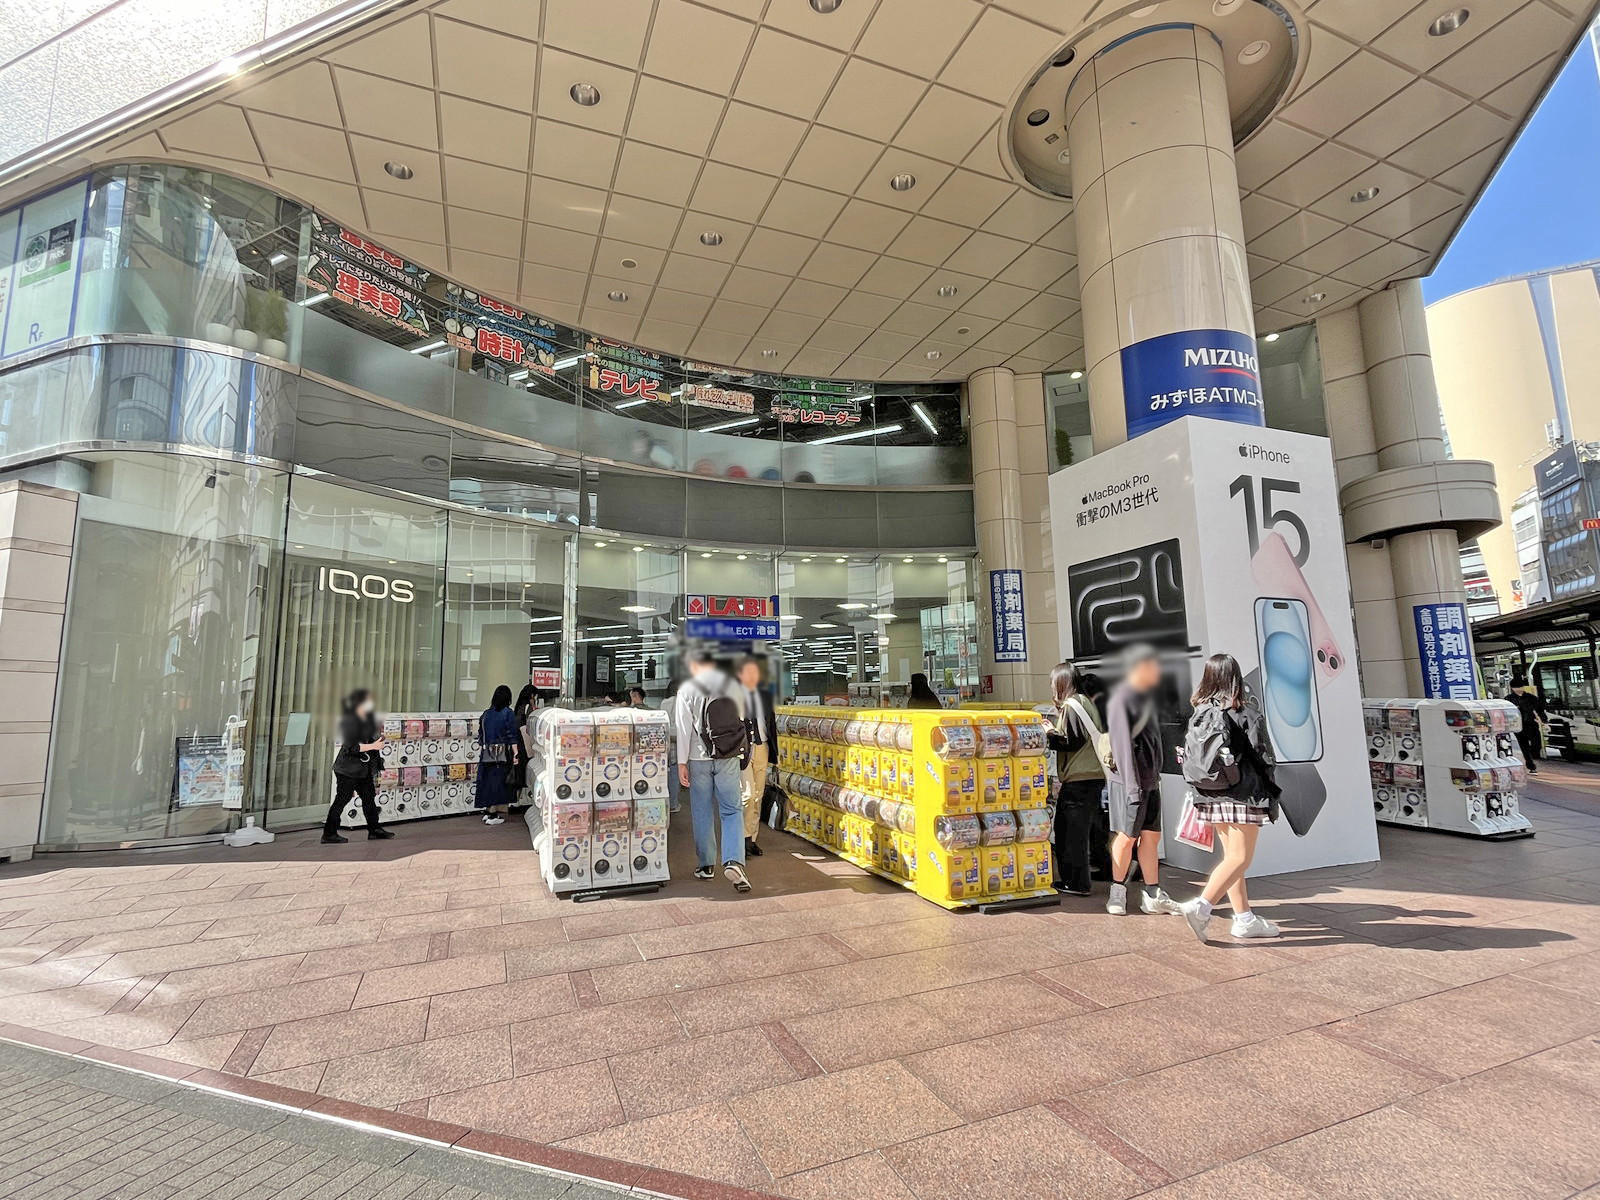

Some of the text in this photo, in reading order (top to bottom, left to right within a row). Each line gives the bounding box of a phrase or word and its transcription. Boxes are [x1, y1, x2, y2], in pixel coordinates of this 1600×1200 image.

[336, 268, 402, 317] 理美容
[478, 328, 525, 363] 時計
[1184, 347, 1258, 373] MIZUHO
[600, 368, 659, 401] テレビ
[800, 408, 860, 425] レコーダー
[1248, 445, 1291, 464] iPhone
[1088, 473, 1150, 503] MacBook Pro
[1075, 486, 1160, 528] 衝撃のM3世代
[1229, 474, 1311, 569] 15
[318, 566, 415, 603] IQOS
[1003, 573, 1024, 651] 調剤薬局
[756, 625, 776, 636] 池袋
